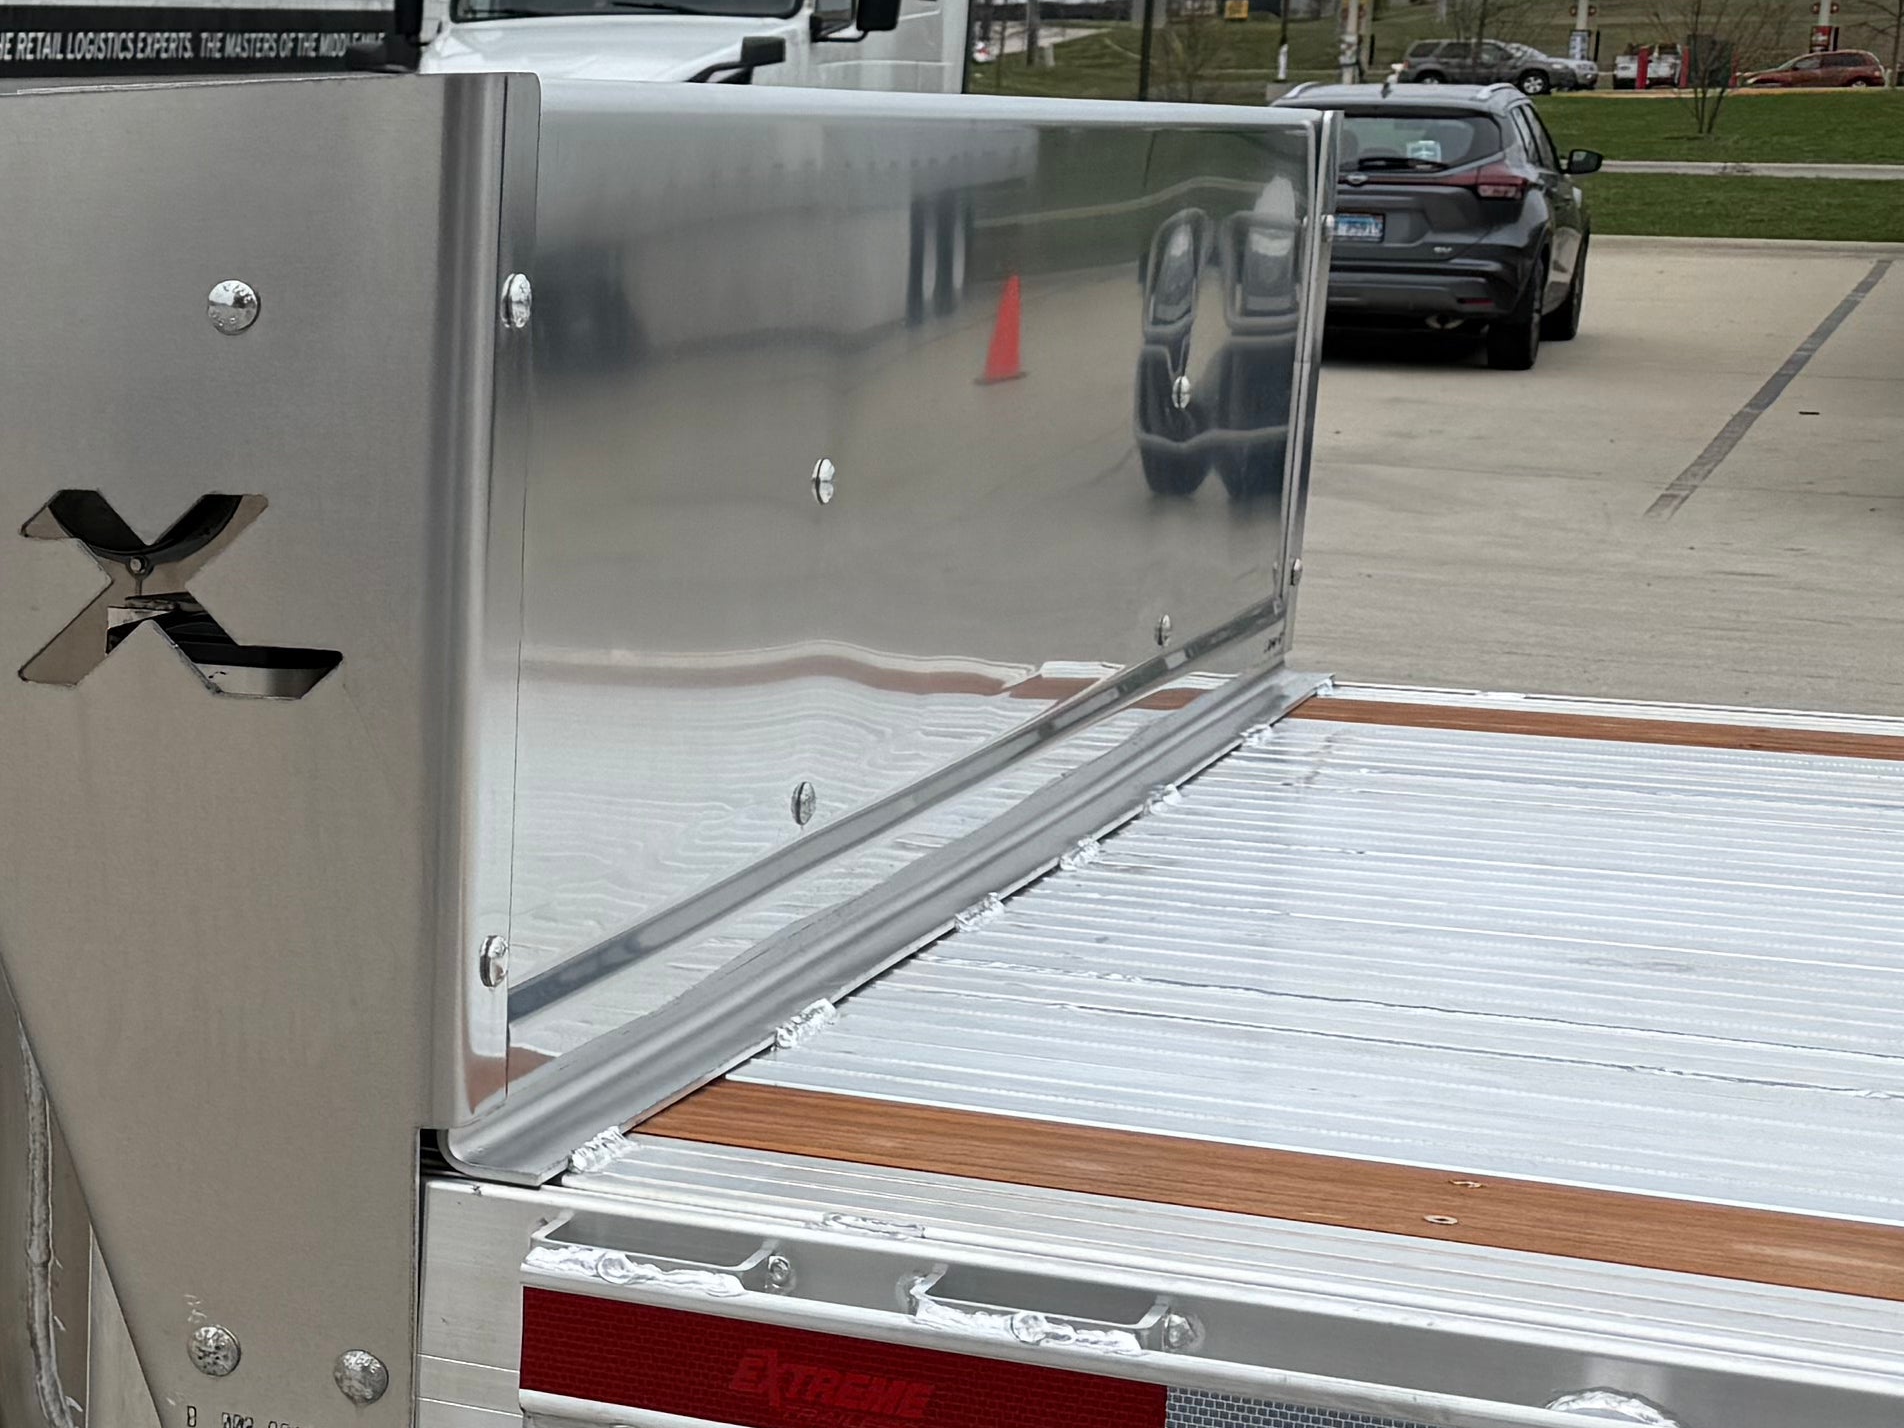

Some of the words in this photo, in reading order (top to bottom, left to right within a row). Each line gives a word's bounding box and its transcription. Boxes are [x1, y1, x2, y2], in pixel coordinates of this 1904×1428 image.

[17, 32, 63, 60] RETAIL
[66, 32, 136, 60] LOGISTICS
[200, 32, 225, 59] THE
[225, 32, 278, 59] MASTERS
[280, 33, 295, 58] OF
[297, 33, 317, 58] THE
[729, 1349, 936, 1419] EXTREME
